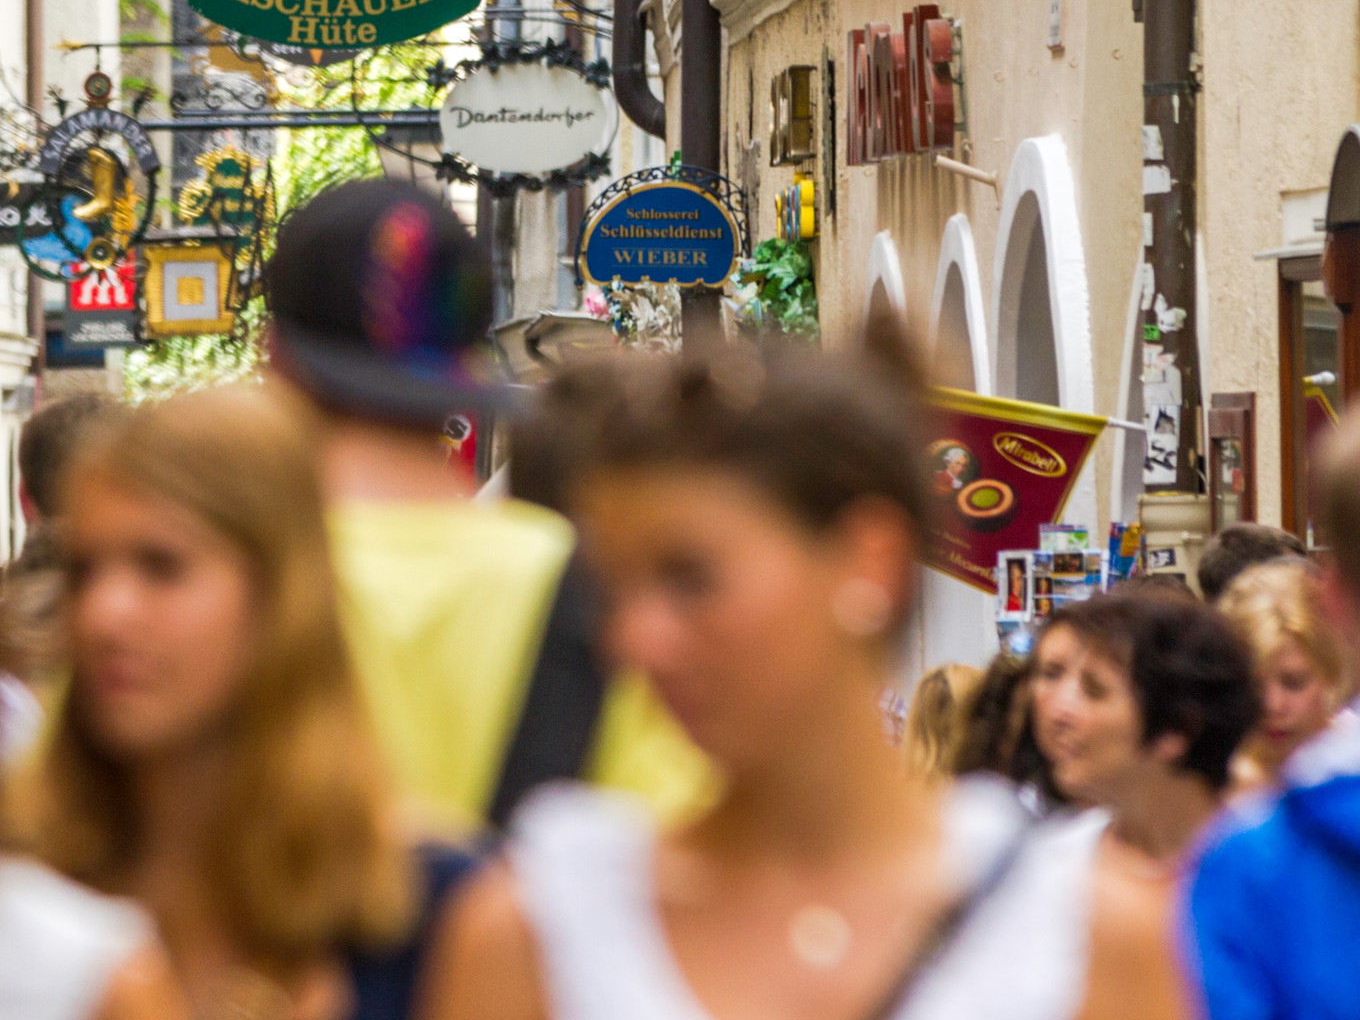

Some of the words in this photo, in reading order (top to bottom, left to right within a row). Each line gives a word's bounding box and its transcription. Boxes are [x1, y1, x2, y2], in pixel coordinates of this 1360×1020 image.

[286, 16, 378, 45] Hüte
[450, 106, 595, 128] Dantendorfer
[626, 208, 700, 221] Schlosserei
[599, 223, 724, 240] Schlüsseldienst
[613, 249, 708, 266] WIEBER
[999, 436, 1058, 474] Mirabell
